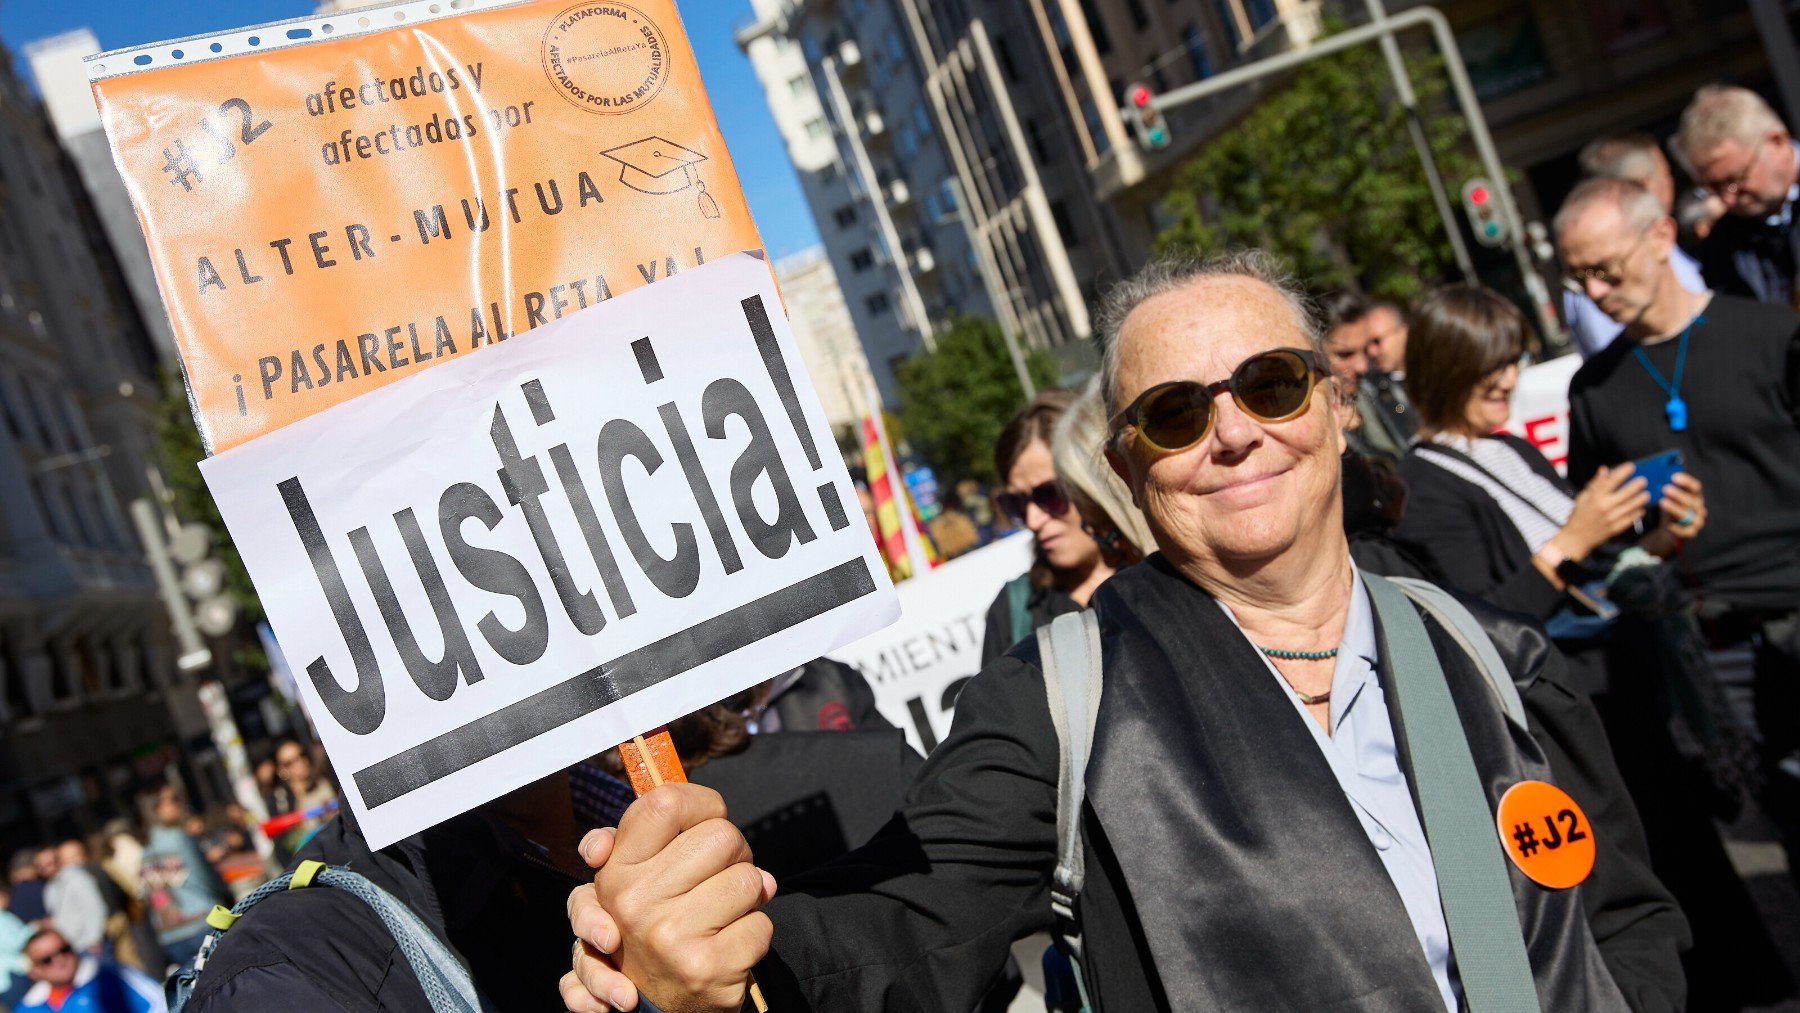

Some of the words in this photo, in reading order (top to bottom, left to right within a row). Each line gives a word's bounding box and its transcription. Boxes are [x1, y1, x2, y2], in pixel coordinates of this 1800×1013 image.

[558, 7, 628, 33] PLATAFORMA
[549, 44, 587, 100] AFECTADOS
[586, 94, 611, 107] POR
[612, 93, 634, 107] LAS
[632, 25, 662, 100] MUTUALIDADES
[566, 42, 647, 64] #PasarelaAlRetaYa
[305, 66, 460, 116] afectados
[161, 97, 273, 192] #J2
[196, 171, 605, 295] ALTER-MUTUA
[470, 302, 515, 348] AL
[275, 293, 851, 736] Justicia!
[1512, 808, 1587, 858] #J2
